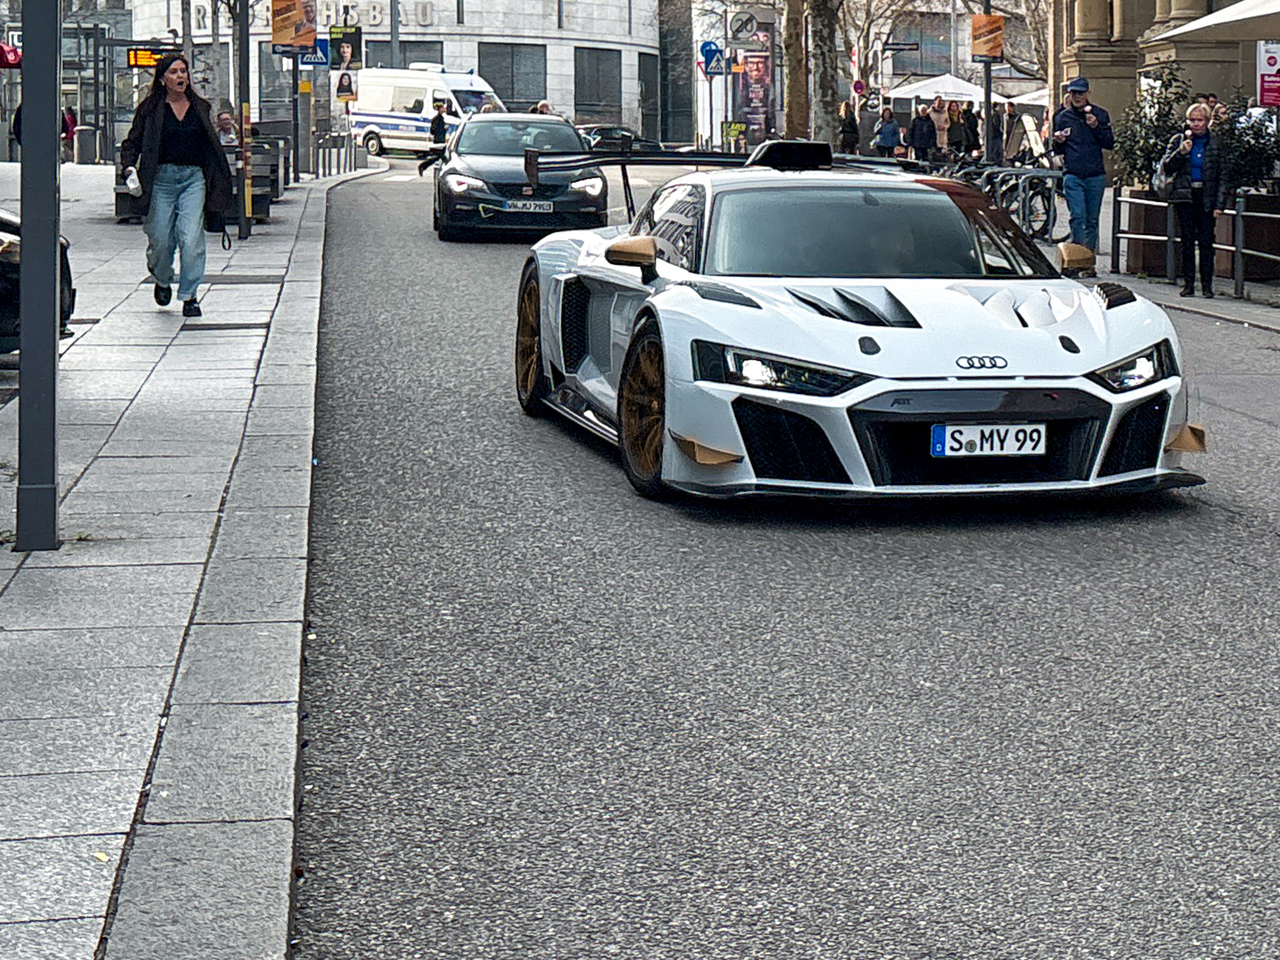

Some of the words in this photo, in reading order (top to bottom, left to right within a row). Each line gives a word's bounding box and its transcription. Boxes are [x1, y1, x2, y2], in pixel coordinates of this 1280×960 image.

[890, 397, 914, 407] ABT
[949, 429, 964, 453] S
[979, 427, 1009, 452] MY
[1015, 428, 1042, 452] 99
